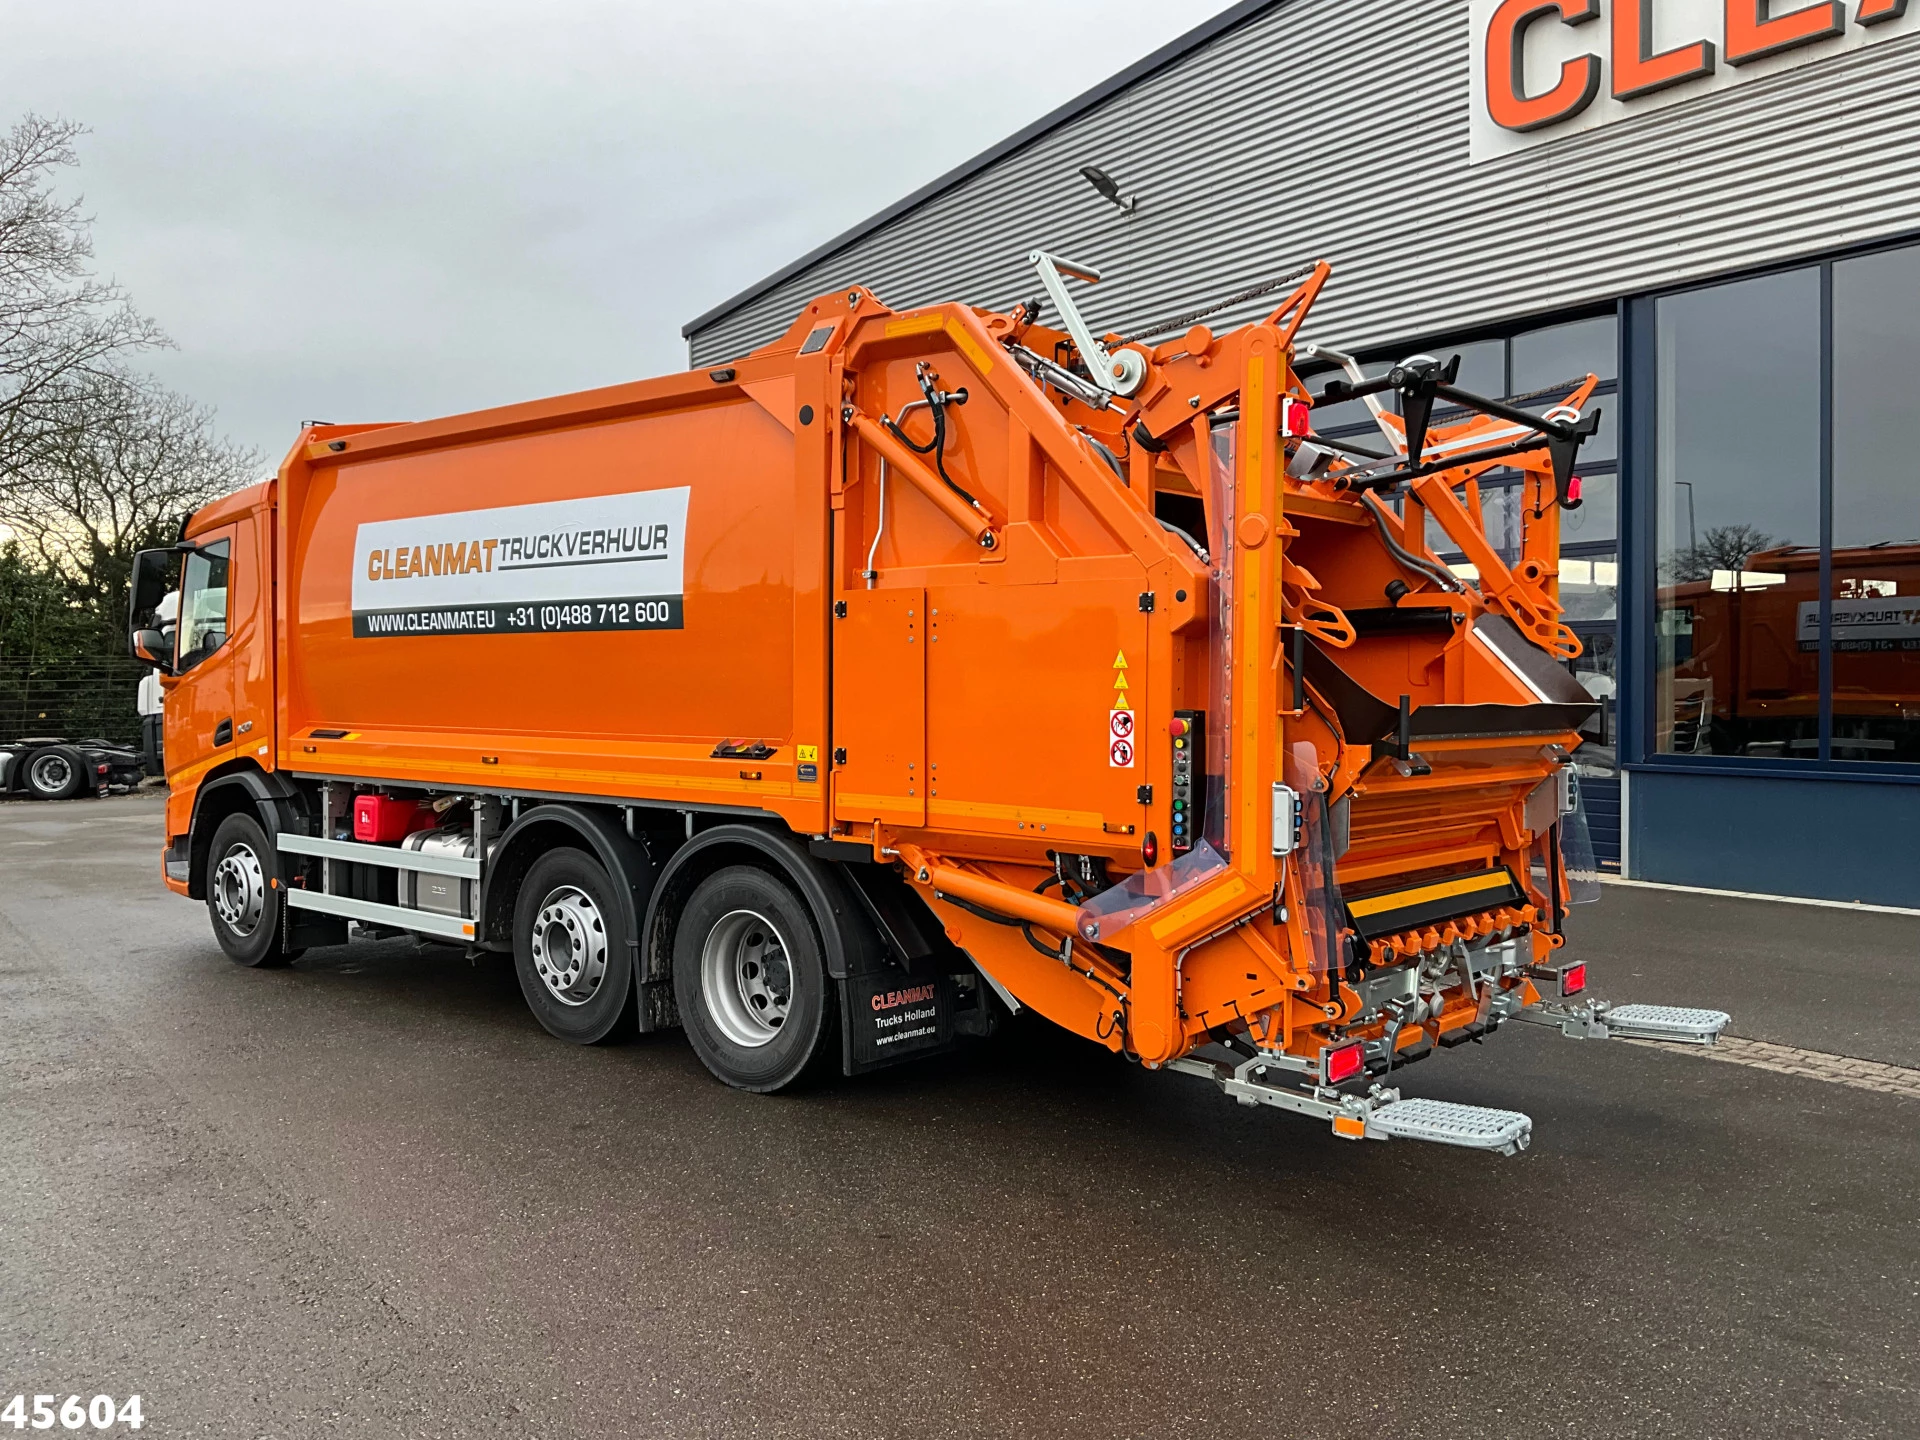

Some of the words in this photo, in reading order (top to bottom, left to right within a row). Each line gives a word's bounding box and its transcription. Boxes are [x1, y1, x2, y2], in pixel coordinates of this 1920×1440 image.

[368, 539, 498, 581] CLEANMAT
[500, 523, 668, 562] TRUCKVERHUUR
[367, 610, 496, 632] WWW.CLEANMAT.EU
[507, 606, 534, 627] +31
[541, 605, 592, 630] (0)488
[597, 603, 630, 624] 712
[634, 601, 669, 623] 600
[871, 984, 935, 1010] CLEANMAT
[875, 1014, 902, 1028] Trucks
[904, 1006, 935, 1022] Holland
[876, 1025, 935, 1045] www.cleanmat.eu
